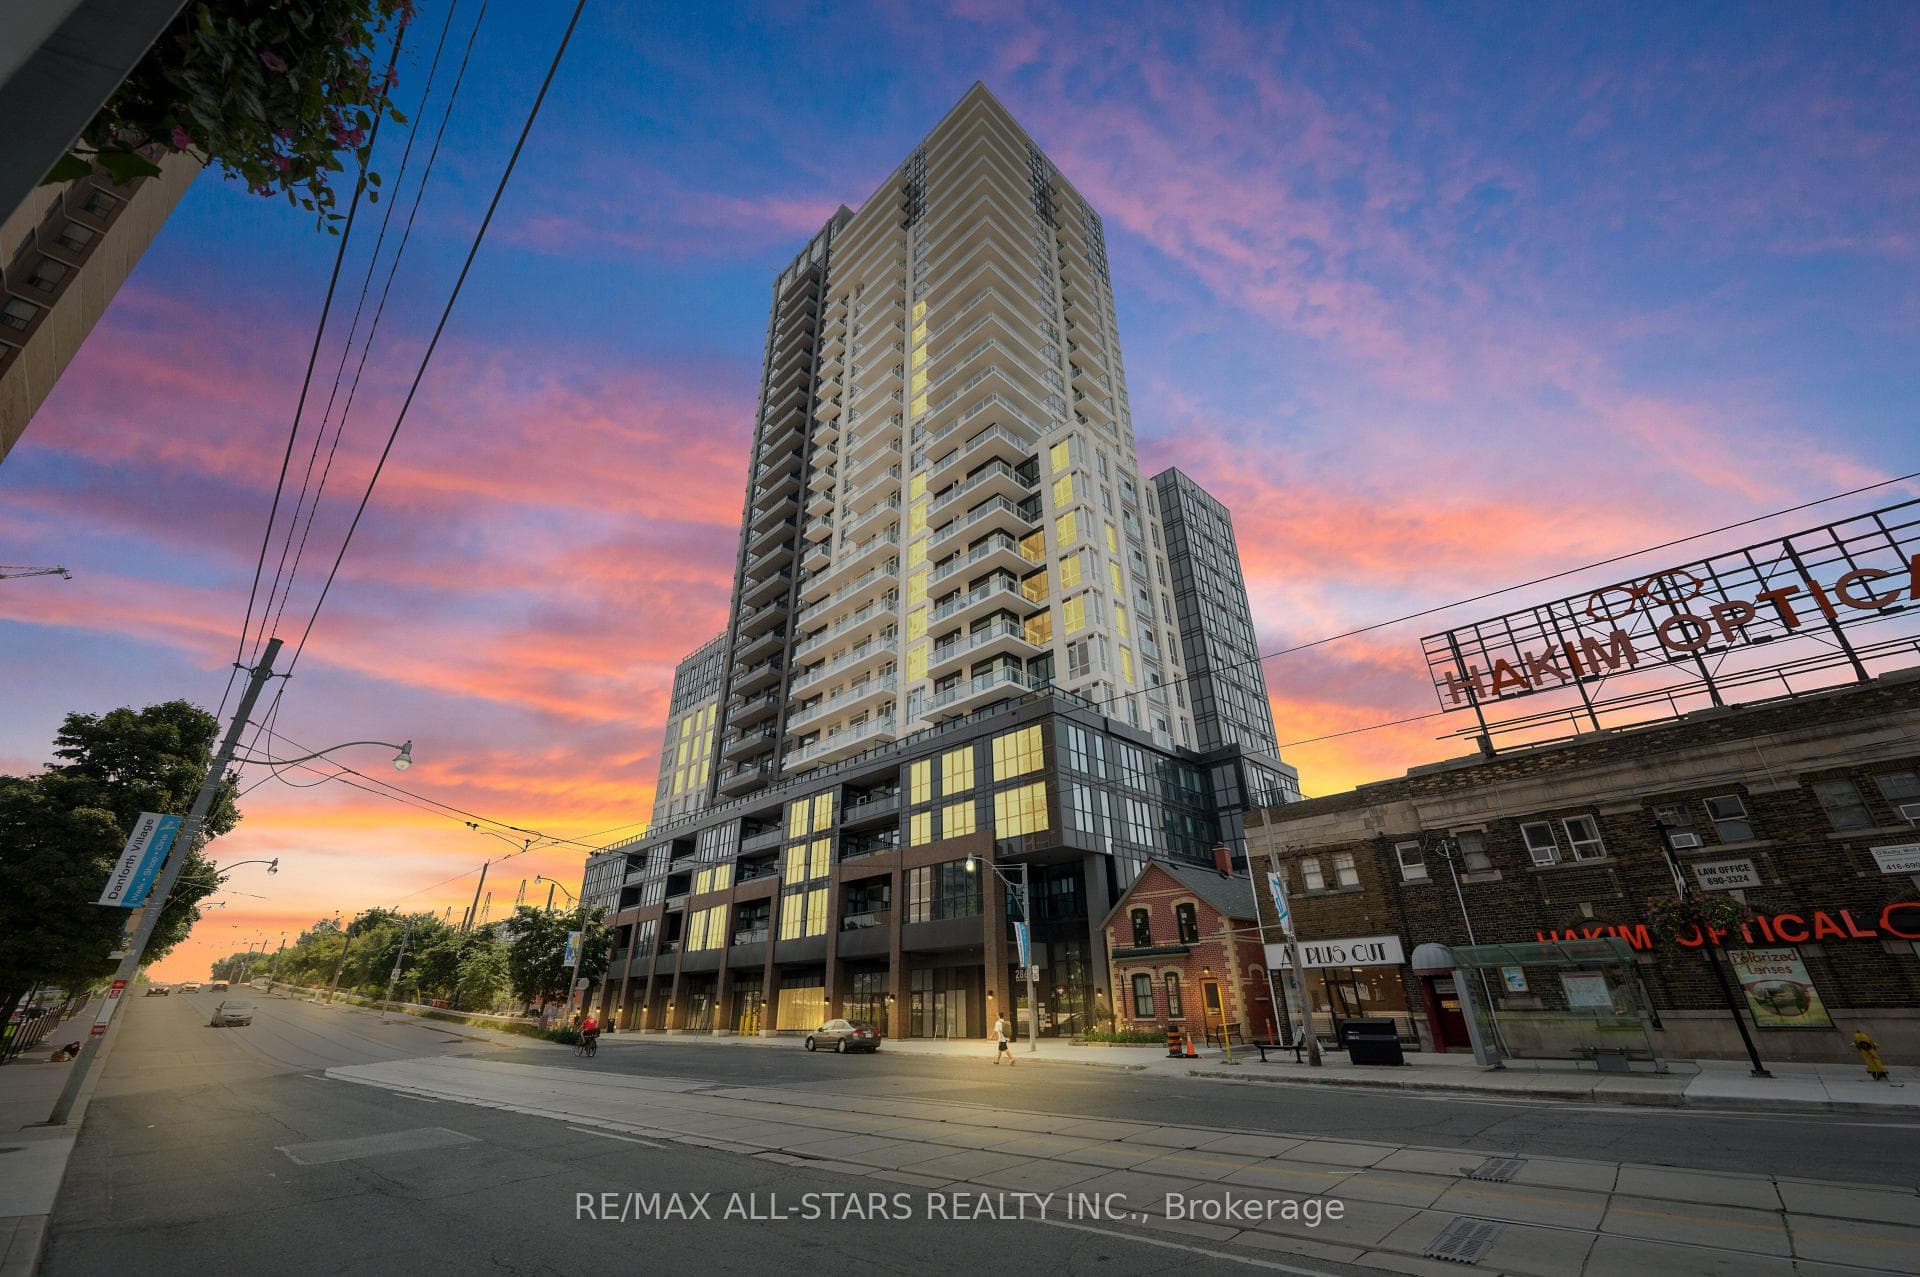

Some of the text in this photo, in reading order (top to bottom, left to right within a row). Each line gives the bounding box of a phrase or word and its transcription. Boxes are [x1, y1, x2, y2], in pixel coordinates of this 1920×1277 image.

[1445, 553, 1920, 704] HAKIM OPTIC
[108, 818, 154, 899] Danforth Village
[144, 857, 157, 876] Shop
[1697, 863, 1751, 876] LAW OFFICE
[1707, 874, 1750, 885] 690-3324
[1304, 945, 1347, 964] PLUS
[1351, 942, 1387, 962] CUT
[1731, 949, 1798, 965] Polarized
[1746, 963, 1793, 975] Lenses
